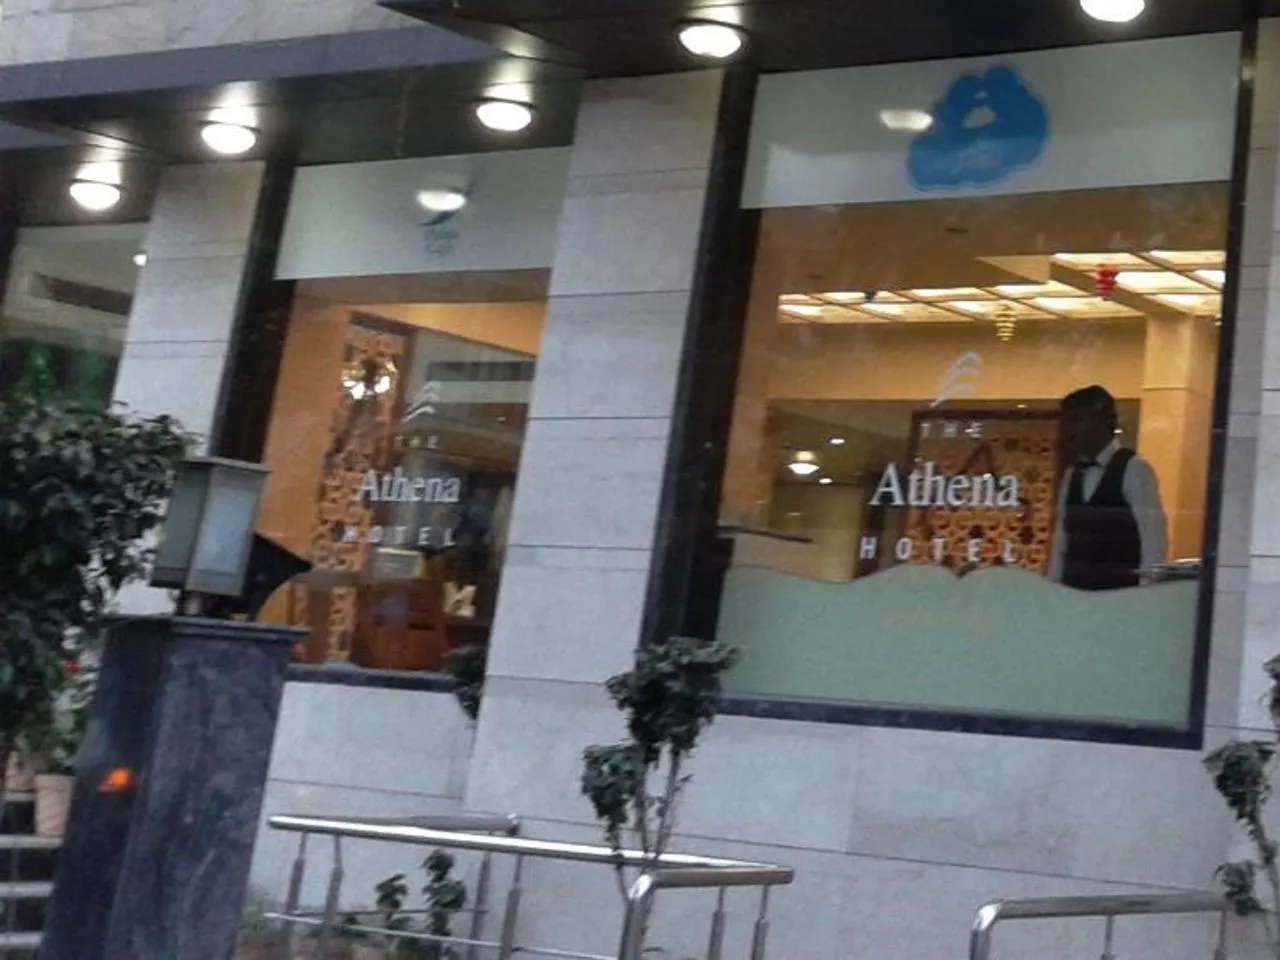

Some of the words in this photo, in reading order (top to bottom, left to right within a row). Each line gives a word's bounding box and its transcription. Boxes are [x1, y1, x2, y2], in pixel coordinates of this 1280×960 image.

[356, 467, 461, 503] Athena
[869, 461, 1022, 508] Athena
[859, 535, 1018, 564] HOTEL
